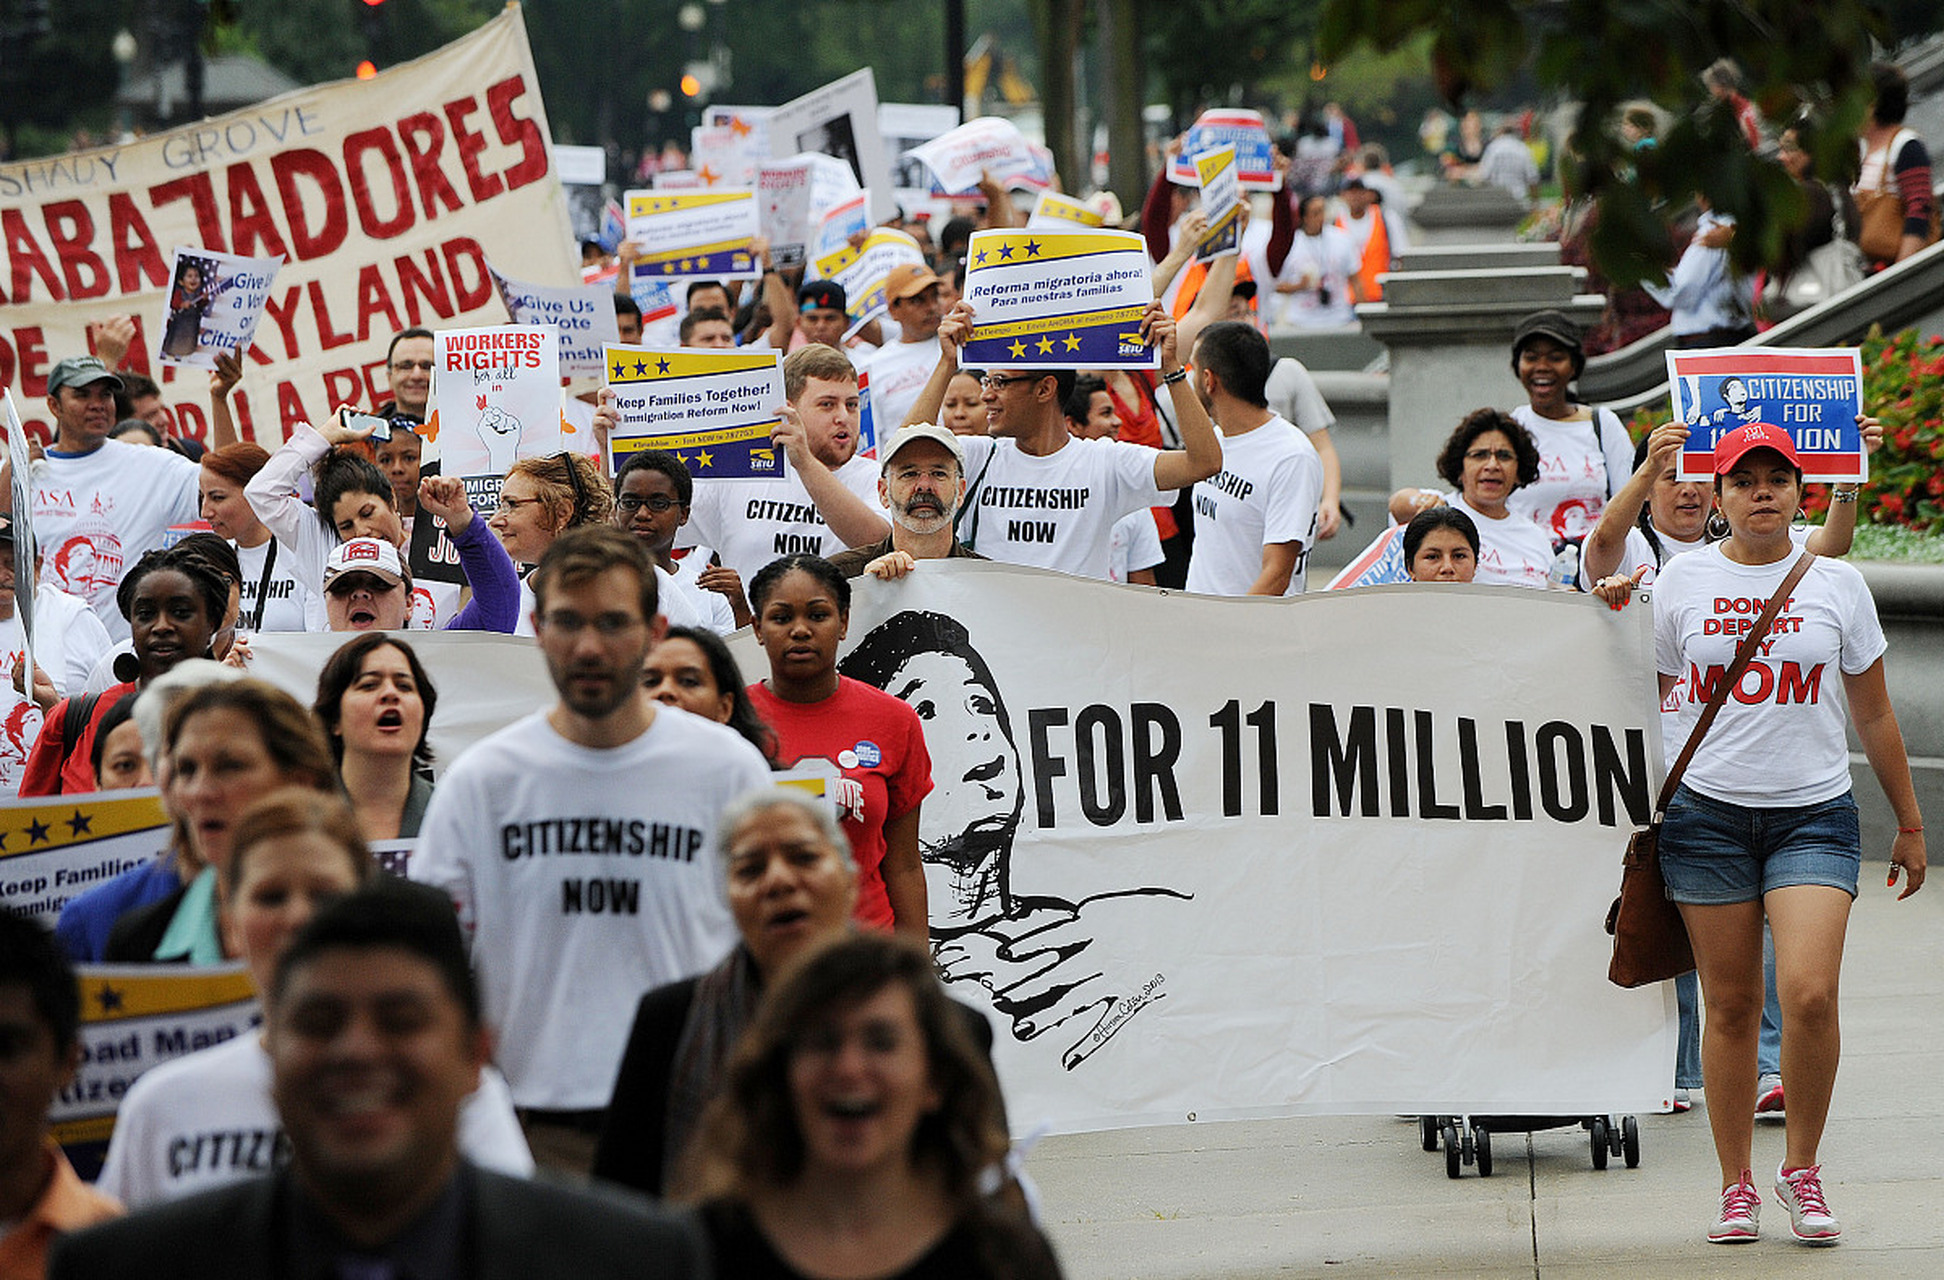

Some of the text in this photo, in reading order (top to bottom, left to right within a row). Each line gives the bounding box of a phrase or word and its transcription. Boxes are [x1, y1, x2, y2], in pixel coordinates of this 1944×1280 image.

[162, 106, 326, 170] GROVE
[0, 74, 548, 305] ABAJADORES
[235, 273, 264, 290] Give
[1033, 273, 1102, 291] migratoria
[86, 237, 493, 383] MYLAND
[232, 296, 243, 309] a
[523, 294, 596, 314] Give Us
[990, 297, 1018, 308] Para
[1021, 290, 1073, 304] nuestras
[446, 349, 542, 372] RIGHTS
[491, 382, 503, 393] in
[616, 382, 771, 411] Keep Families Together!
[1747, 378, 1856, 401] CITIZENSHIP
[623, 401, 762, 424] Immigration Reform Now!
[1782, 403, 1822, 423] FOR
[980, 486, 1090, 511] CITIZENSHIP
[1006, 519, 1057, 544] NOW
[773, 533, 823, 557] NOW
[1687, 660, 1828, 706] MOM
[1027, 699, 1652, 830] FOR 11 MILLION
[502, 817, 704, 864] CITIZENSHIP
[562, 877, 642, 916] NOW
